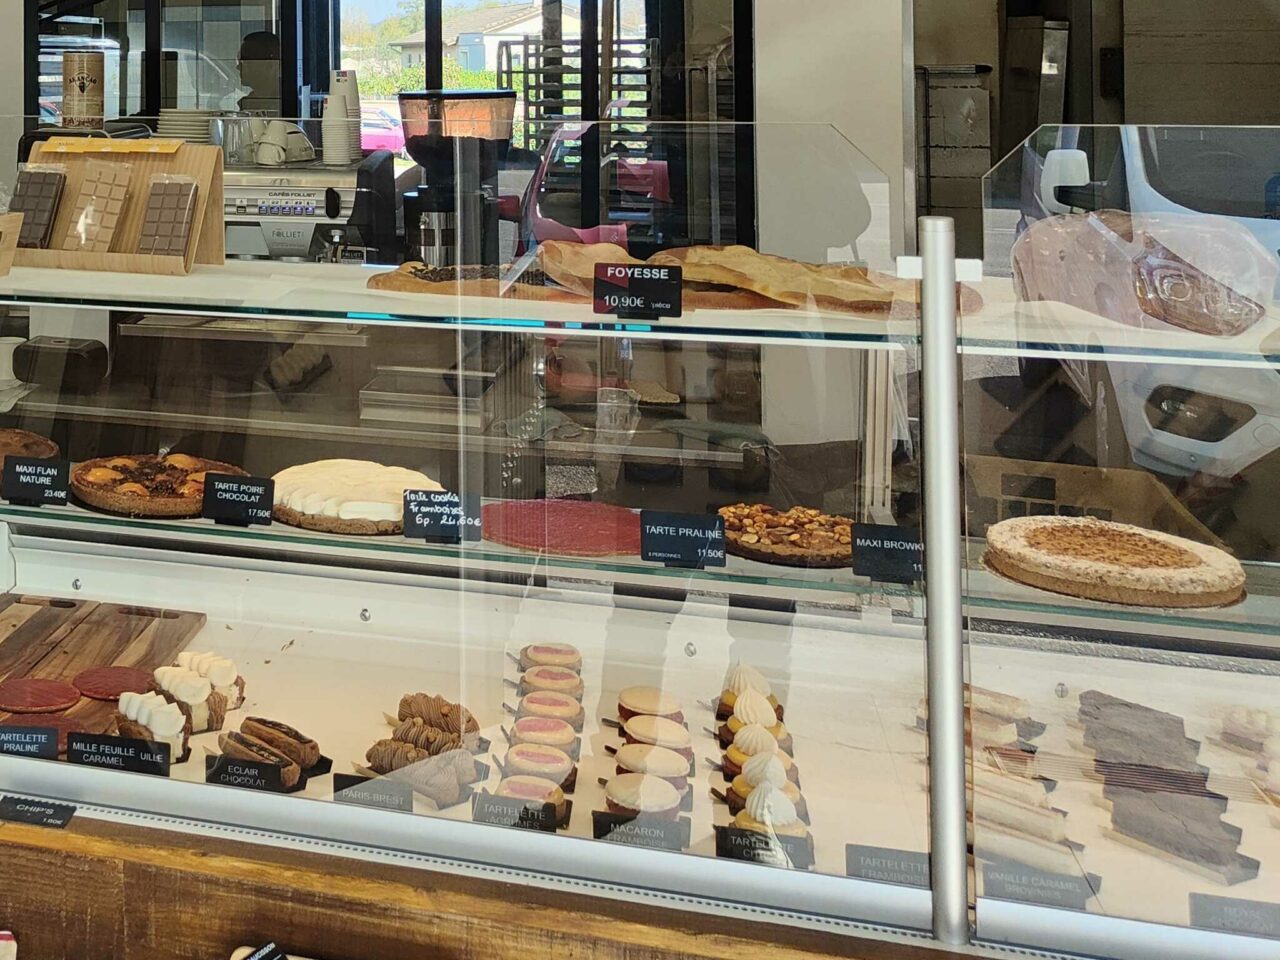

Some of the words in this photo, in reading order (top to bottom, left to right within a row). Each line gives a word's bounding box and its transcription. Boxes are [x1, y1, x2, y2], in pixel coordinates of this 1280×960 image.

[607, 267, 669, 279] FOYESSE
[604, 295, 645, 308] 10,90€
[16, 464, 35, 473] MAXI
[37, 467, 58, 476] FLAN
[20, 475, 52, 485] NATURE
[214, 482, 238, 491] TARTE
[240, 485, 265, 494] POIRE
[217, 492, 260, 503] CHOCOLAT
[403, 490, 428, 501] Tarte
[645, 525, 676, 536] TARTE
[679, 528, 723, 539] PRALINE
[856, 538, 881, 548] MAXI
[4, 743, 39, 753] PRALINE
[72, 742, 98, 752] MILLE
[100, 744, 135, 757] FEUILLE
[82, 754, 125, 767] CARAMEL
[228, 765, 259, 776] ECLAIR
[220, 774, 266, 787] CHOCOLAT
[342, 789, 404, 805] PARIS-BREST
[16, 804, 54, 815] CHIP'S
[484, 804, 546, 821] TARTELETTE
[610, 823, 664, 838] MACARON
[987, 871, 1027, 885] VANILLE
[1031, 875, 1080, 892] CARAMEL
